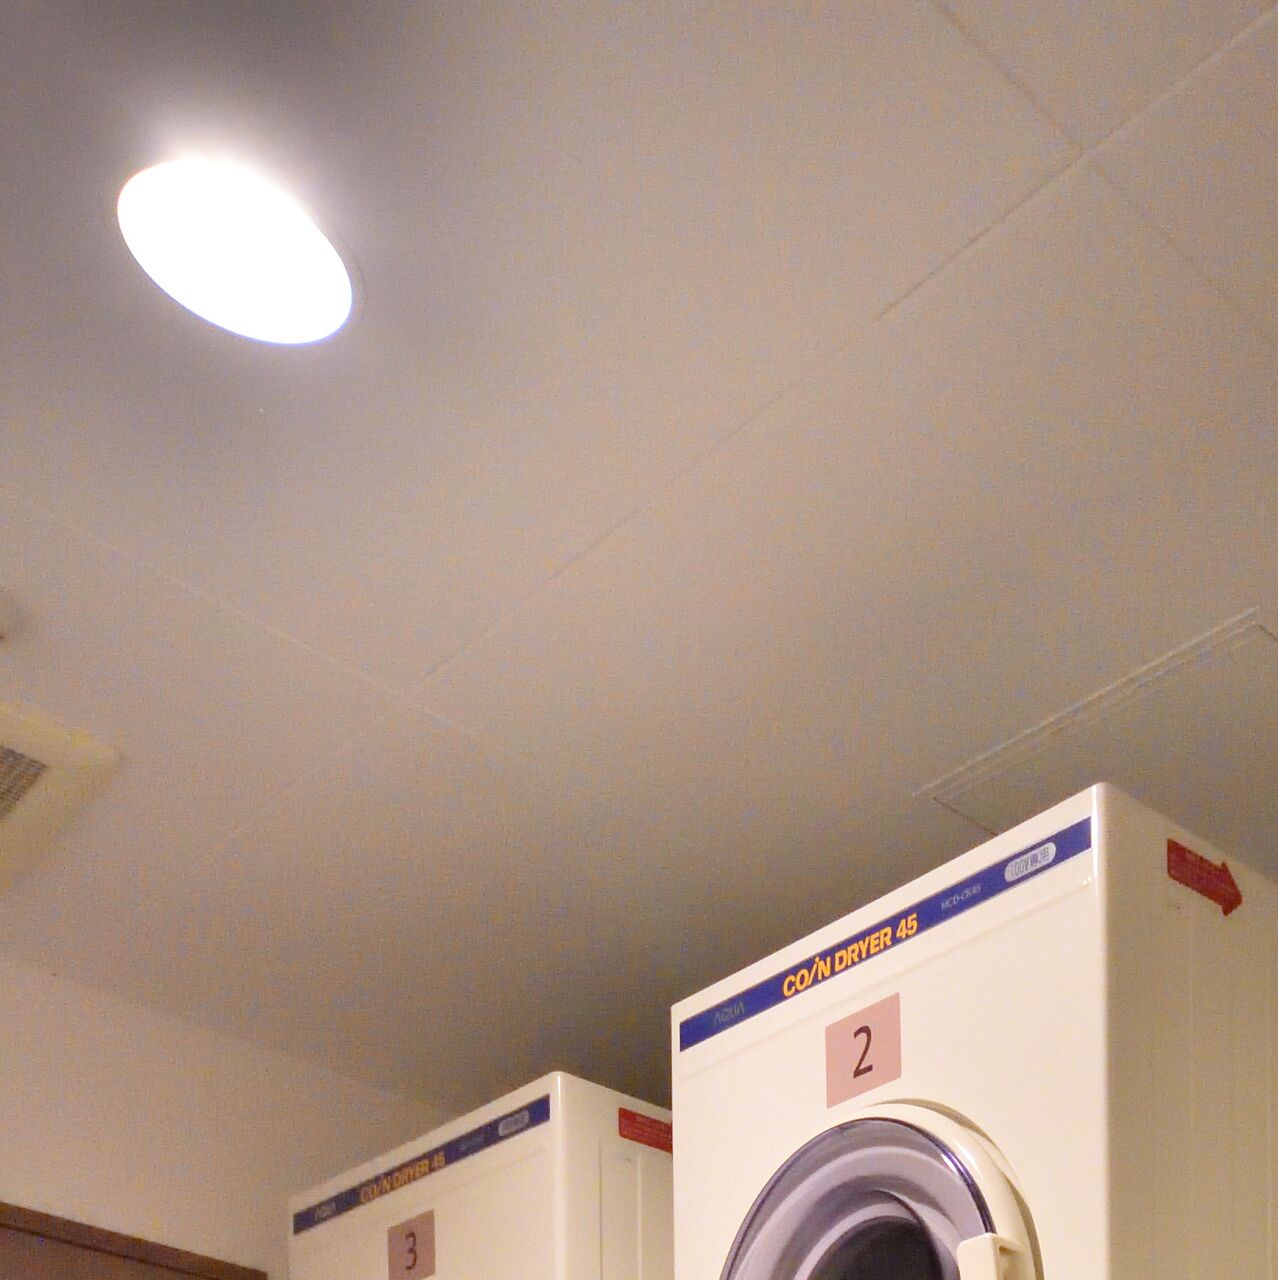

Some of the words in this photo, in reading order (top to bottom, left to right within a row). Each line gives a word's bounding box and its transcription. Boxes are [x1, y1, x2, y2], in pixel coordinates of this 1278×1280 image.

[833, 926, 893, 973] DRYER
[896, 913, 918, 939] 45
[852, 1026, 874, 1078] 2
[391, 1160, 430, 1188] DRYER
[431, 1152, 446, 1169] 45
[405, 1230, 418, 1270] 3
